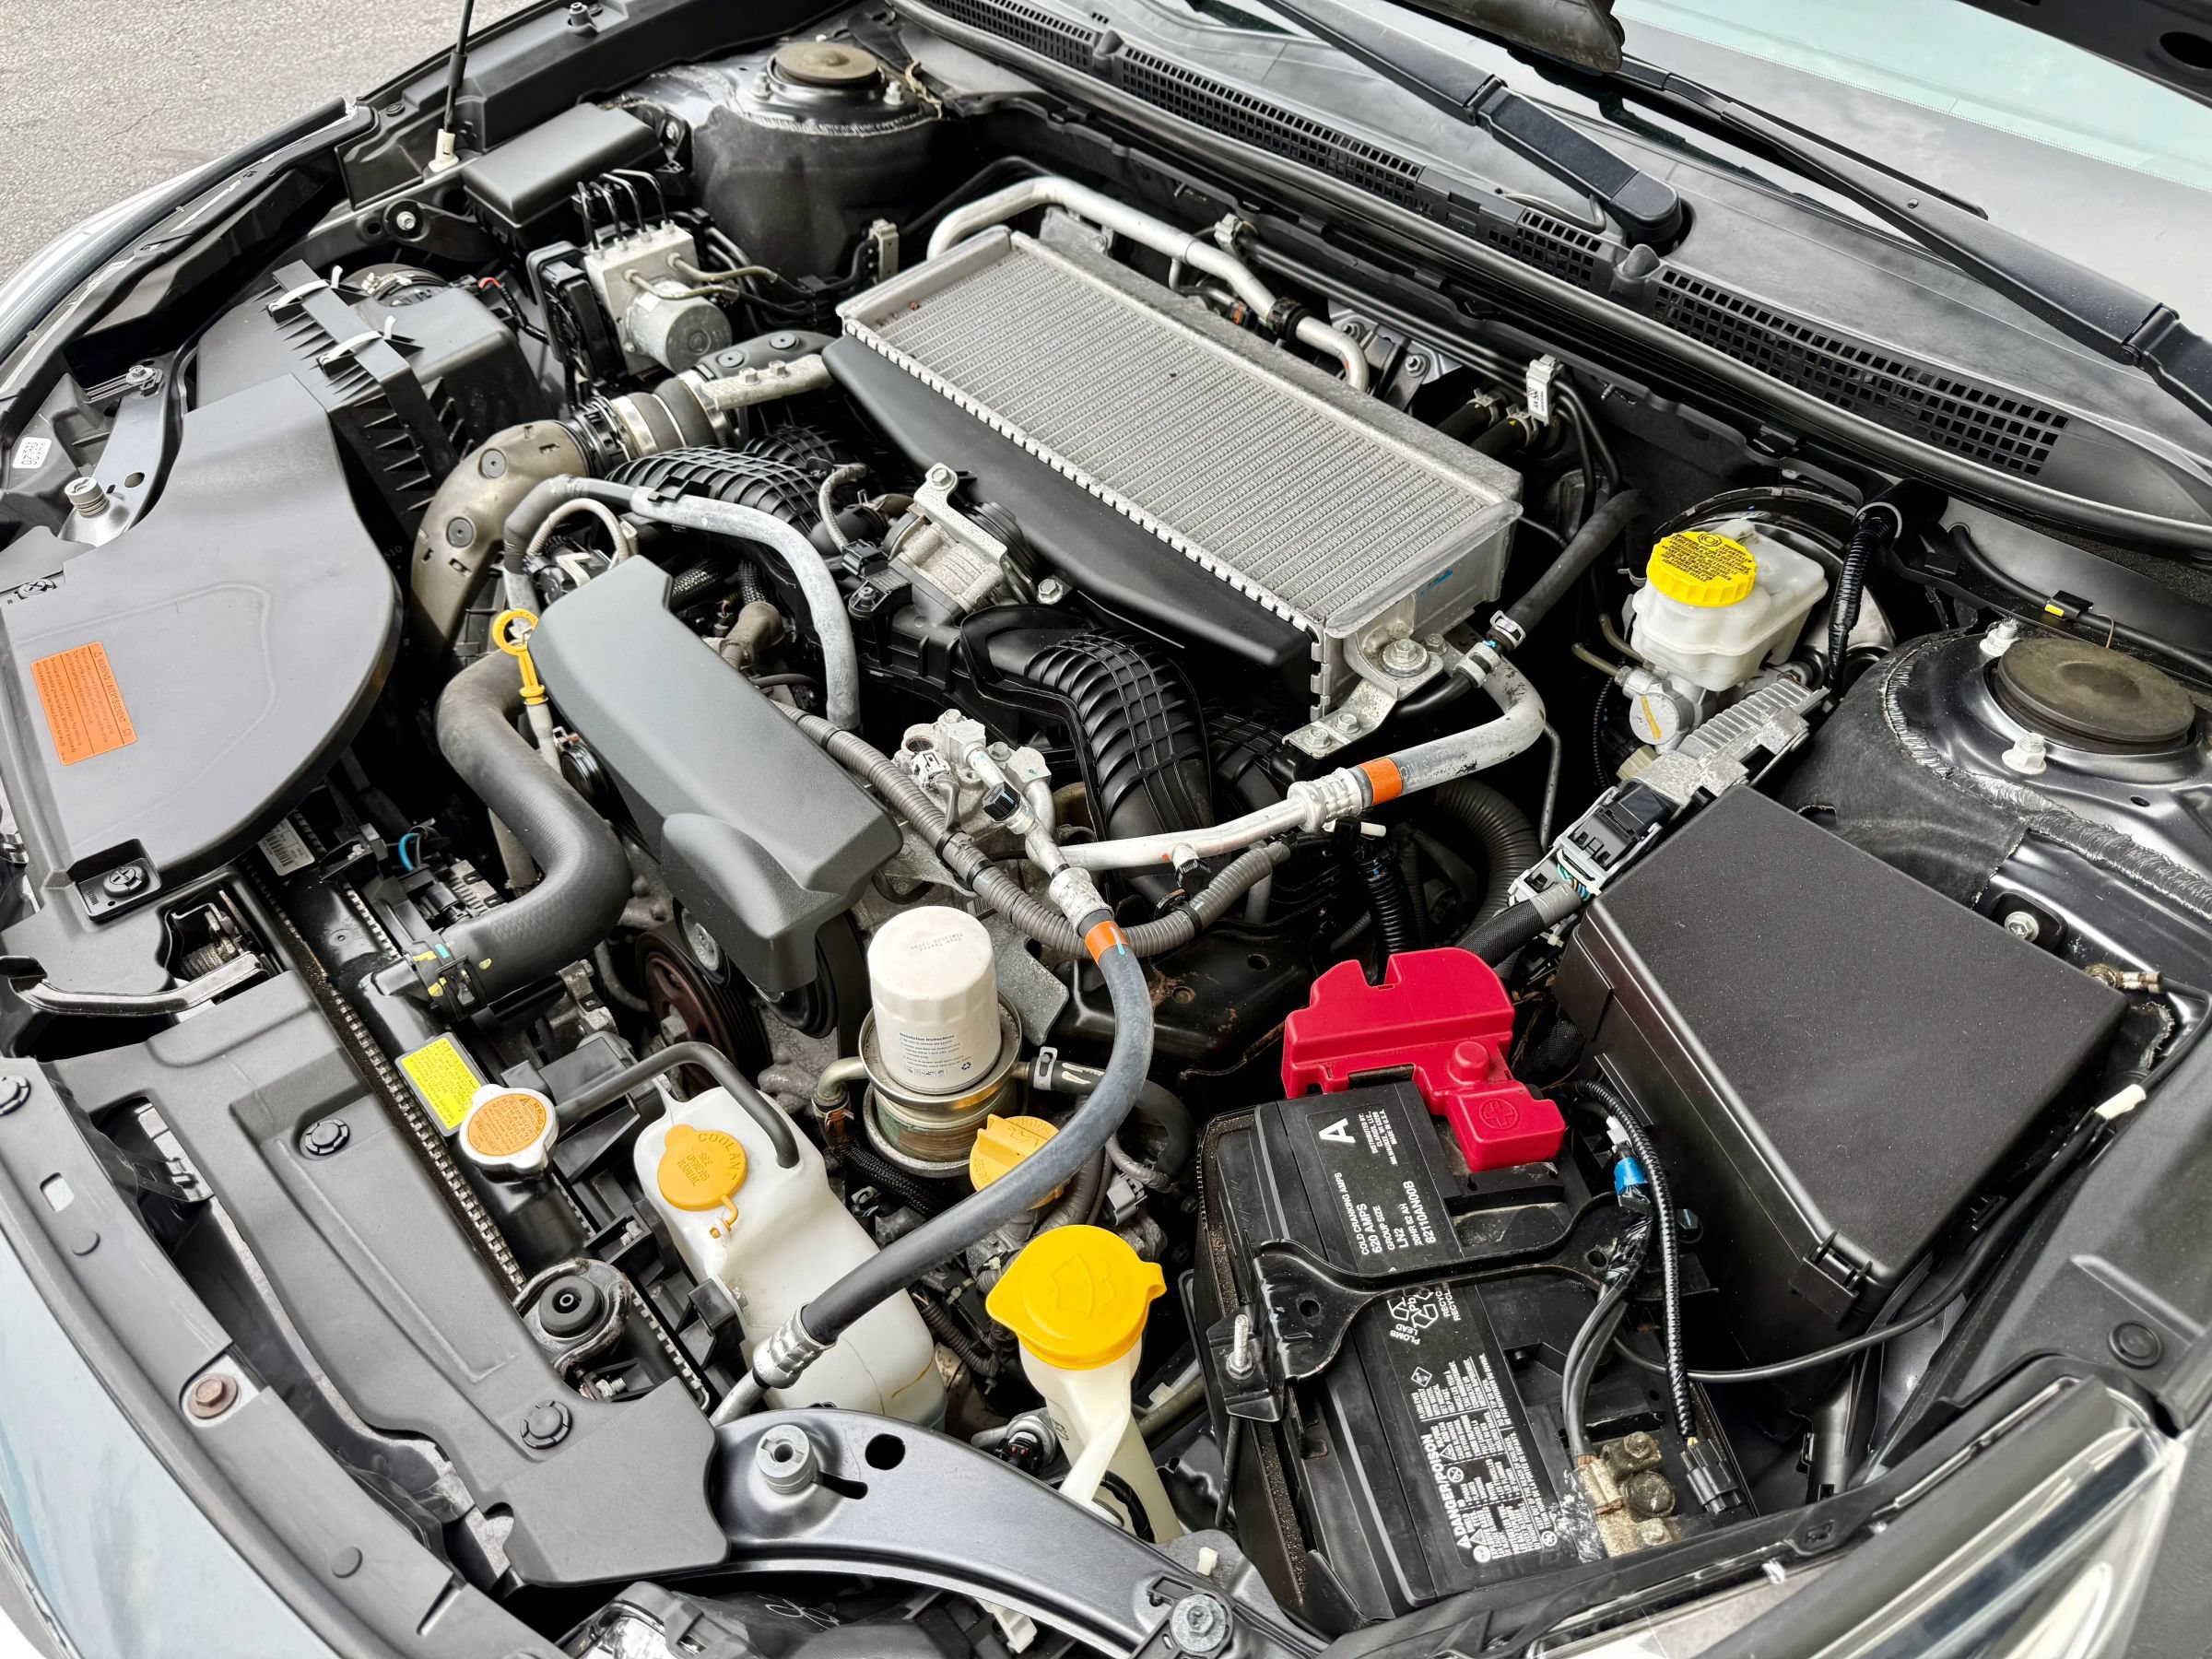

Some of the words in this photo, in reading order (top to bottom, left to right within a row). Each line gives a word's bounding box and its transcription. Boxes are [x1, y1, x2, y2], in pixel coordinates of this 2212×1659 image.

[96, 657, 111, 680] WARNING
[104, 683, 126, 723] AVERTISSEMENT
[1378, 1108, 1389, 1124] U.S.A.
[1318, 1118, 1357, 1144] A
[1360, 1121, 1378, 1153] DISTRIBUTED
[1377, 1125, 1385, 1134] WI
[1386, 1129, 1397, 1145] MADE
[1380, 1133, 1397, 1164] MILWAUKEE,
[677, 1159, 700, 1186] MANUAL
[1334, 1171, 1347, 1194] AMPS
[1341, 1193, 1361, 1232] CRANKING
[1355, 1202, 1375, 1233] AMPS
[1371, 1205, 1385, 1222] SIZE
[1399, 1202, 1410, 1215] AH
[1402, 1179, 1436, 1244] 82110AN00B
[1404, 1215, 1414, 1225] 62
[1355, 1232, 1370, 1255] COLD
[1367, 1233, 1382, 1253] 620
[1379, 1221, 1395, 1251] GROUP
[1393, 1226, 1409, 1248] LN2
[1407, 1224, 1422, 1246] 20HR
[1405, 1296, 1419, 1312] Pb
[1434, 1289, 1451, 1317] RECYC
[1442, 1288, 1461, 1321] RECYCL
[1389, 1329, 1420, 1345] PLOMB
[1395, 1323, 1418, 1335] LEAD
[1477, 1352, 1491, 1372] OUVRIR.
[1480, 1377, 1492, 1392] OPEN.
[1486, 1371, 1494, 1380] OU
[1410, 1391, 1421, 1404] EYES
[1424, 1385, 1437, 1404] WATER.
[1431, 1383, 1445, 1405] MEDICAL
[1441, 1387, 1452, 1400] FAST.
[1486, 1392, 1495, 1400] OR
[1488, 1379, 1505, 1407] RENVERSER
[1415, 1403, 1427, 1419] FLUSH
[1417, 1387, 1434, 1418] IMMEDIATELY
[1430, 1403, 1441, 1416] WITH
[1440, 1404, 1449, 1415] GET
[1445, 1400, 1456, 1413] HELP
[1488, 1399, 1498, 1408] TIP
[1491, 1407, 1502, 1418] NOT
[1500, 1407, 1510, 1418] PAS
[1503, 1417, 1512, 1425] NE
[1438, 1421, 1447, 1430] CAN
[1430, 1424, 1445, 1447] SULFURIC
[1441, 1430, 1451, 1442] ACID
[1502, 1434, 1519, 1462] CHILDREN.
[1493, 1460, 1509, 1484] FLAMMES
[1504, 1467, 1517, 1485] FUMER
[1515, 1468, 1528, 1487] REACH
[1419, 1432, 1466, 1536] DANGER/POISON
[1459, 1482, 1473, 1502] SPARKS
[1466, 1480, 1480, 1500] FLAMES
[1473, 1476, 1488, 1499] SMOKING
[1483, 1481, 1499, 1500] ÉVITER
[1495, 1485, 1504, 1495] LES
[1502, 1484, 1512, 1494] LES
[1511, 1484, 1520, 1492] DE
[1522, 1486, 1533, 1497] THE
[1530, 1504, 1540, 1515] OUT
[1534, 1515, 1546, 1530] KEEP
